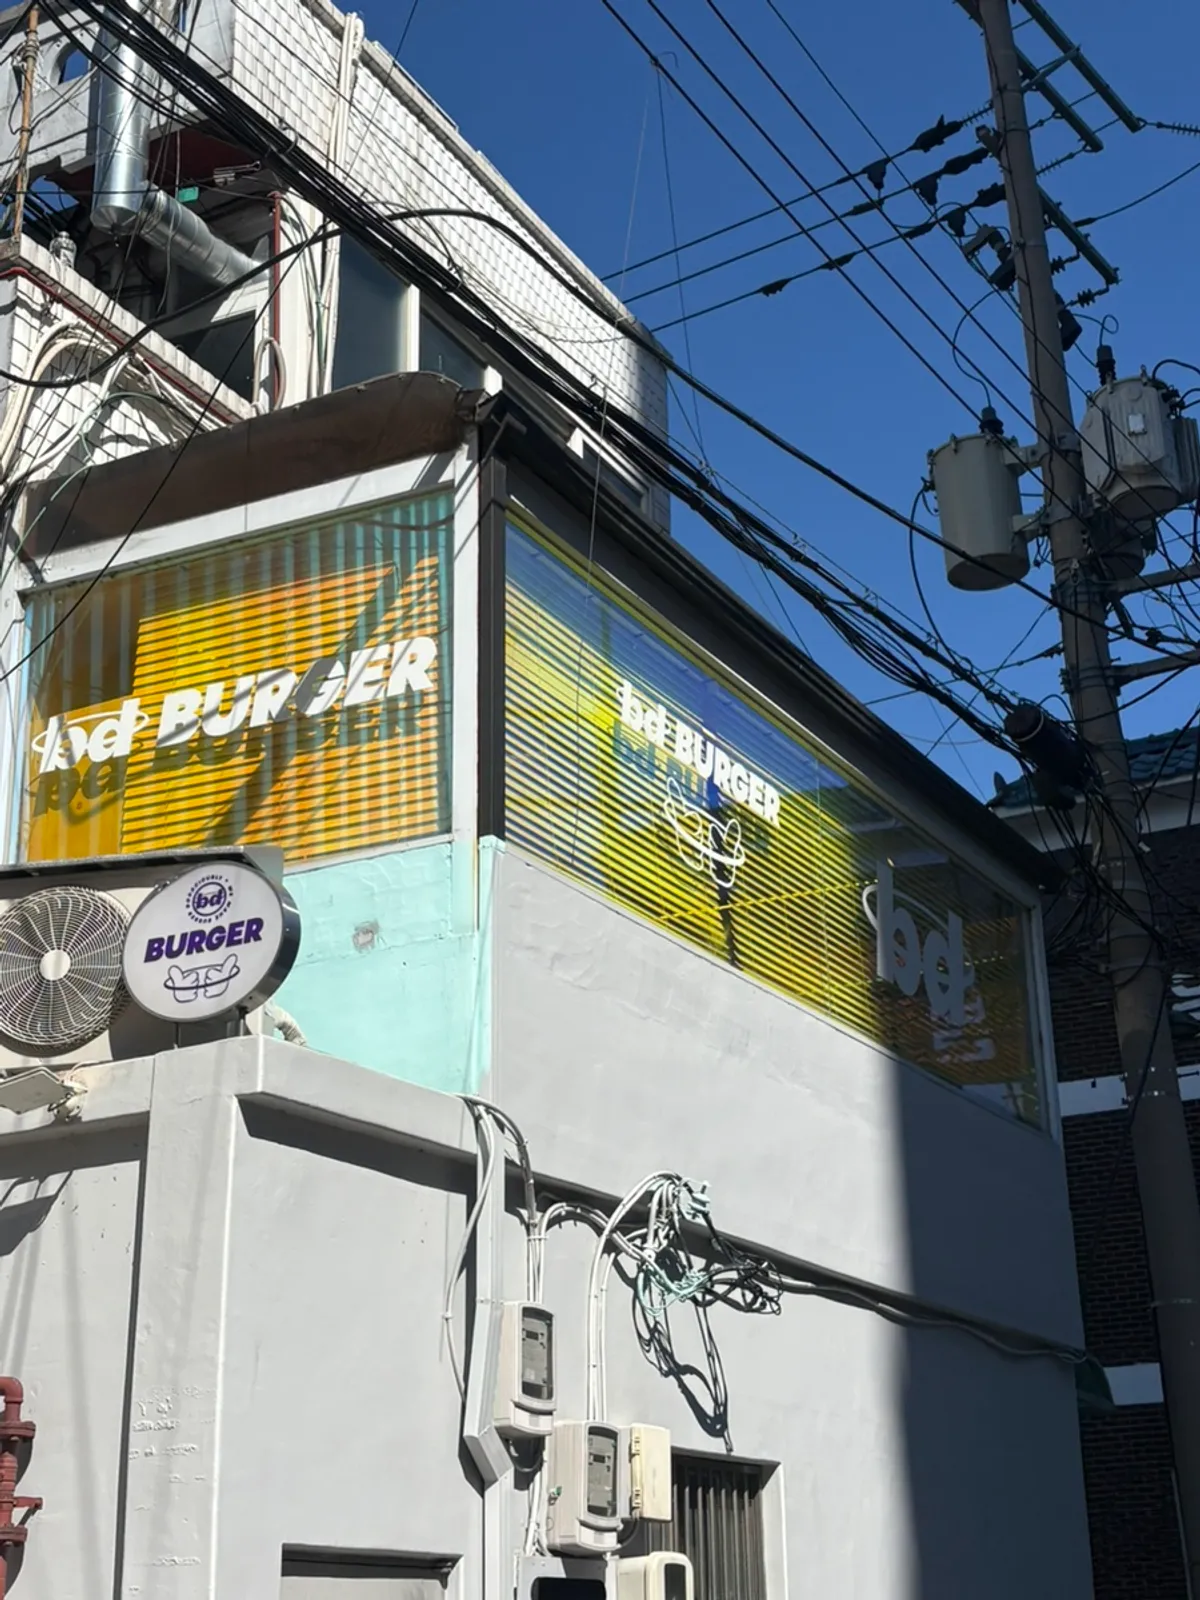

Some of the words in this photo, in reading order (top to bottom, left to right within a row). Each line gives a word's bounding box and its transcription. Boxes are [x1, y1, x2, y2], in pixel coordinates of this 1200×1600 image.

[38, 698, 141, 774] bd
[156, 636, 438, 748] BURGER
[620, 679, 668, 746] bd
[675, 719, 781, 828] BURGER
[144, 917, 264, 963] BURGER
[195, 888, 224, 910] bd
[876, 858, 967, 1026] bd
